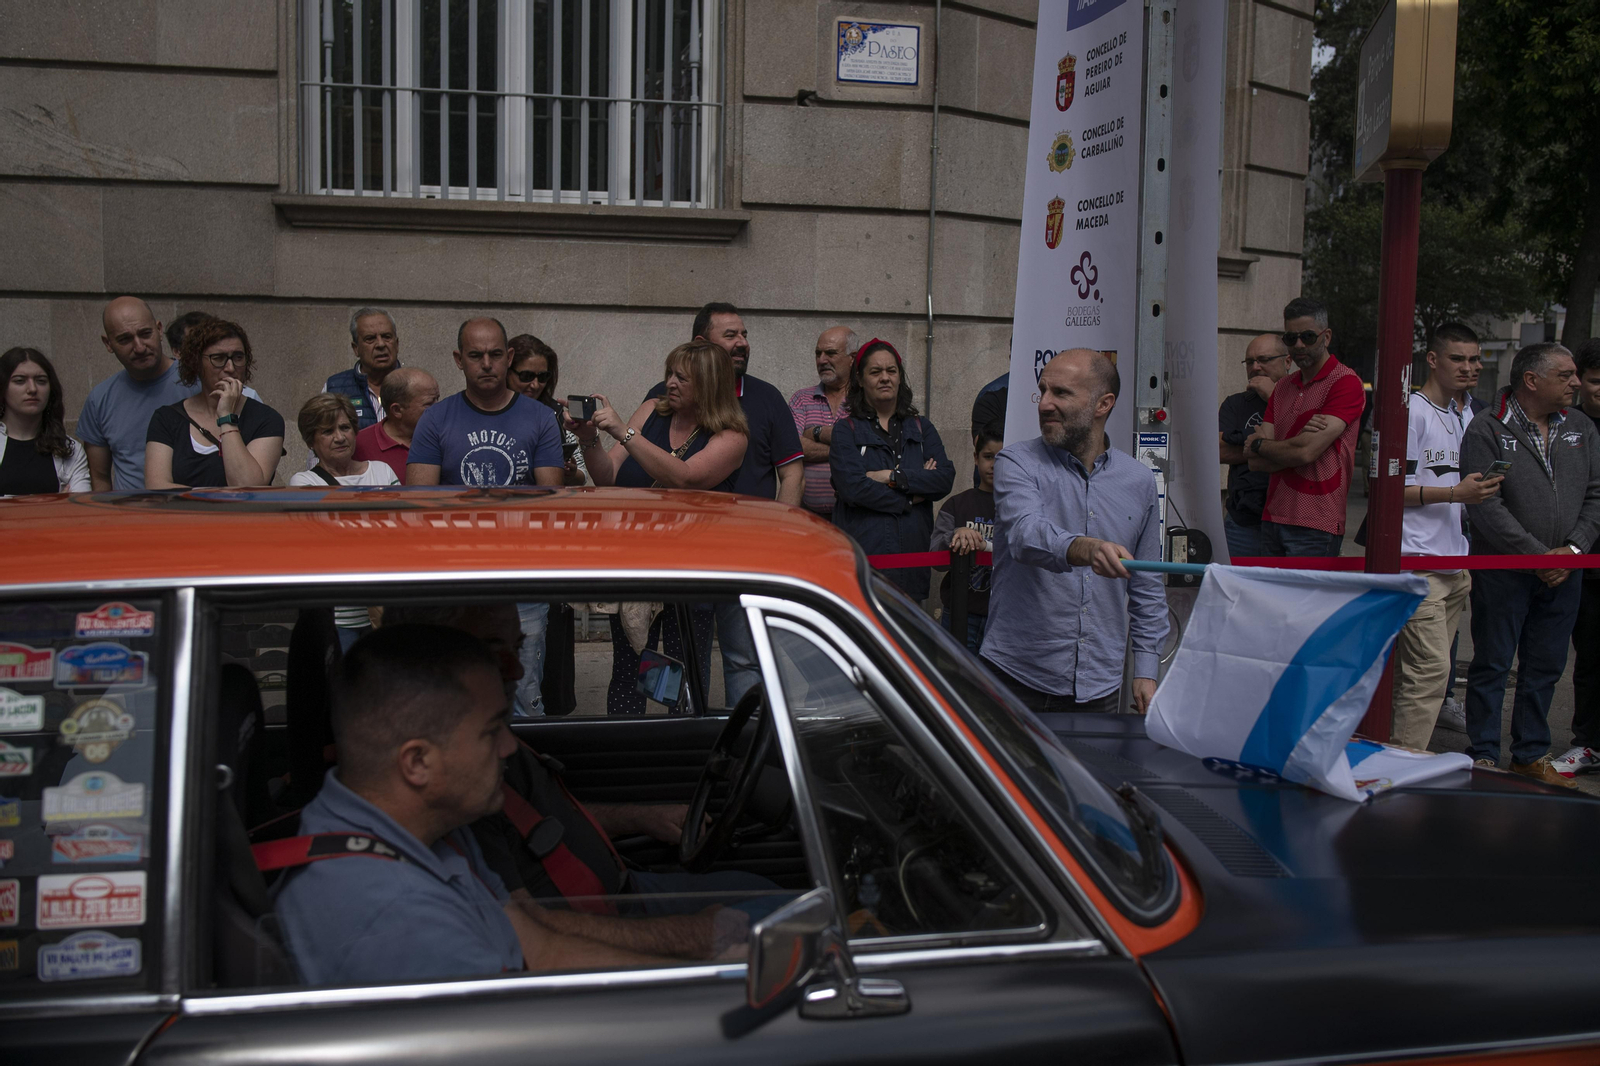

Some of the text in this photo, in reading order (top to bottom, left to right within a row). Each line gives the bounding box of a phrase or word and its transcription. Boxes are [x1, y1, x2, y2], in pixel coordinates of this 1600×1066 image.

[868, 40, 917, 60] PASEO
[1086, 31, 1127, 62] CONCELLO DE
[1085, 52, 1123, 80] PEREIRO DE
[1084, 76, 1111, 98] AGUIAR
[1082, 116, 1124, 142] CONCELLO DE
[1081, 133, 1124, 159] CARBALLIÑO
[1077, 190, 1124, 212] CONCELLO DE
[1075, 213, 1109, 231] MACEDA
[1065, 315, 1101, 327] GALLEGAS
[1067, 305, 1100, 317] BODEGAS
[467, 429, 517, 450] MOTOR
[1501, 438, 1518, 452] 27
[1423, 449, 1446, 464] Los
